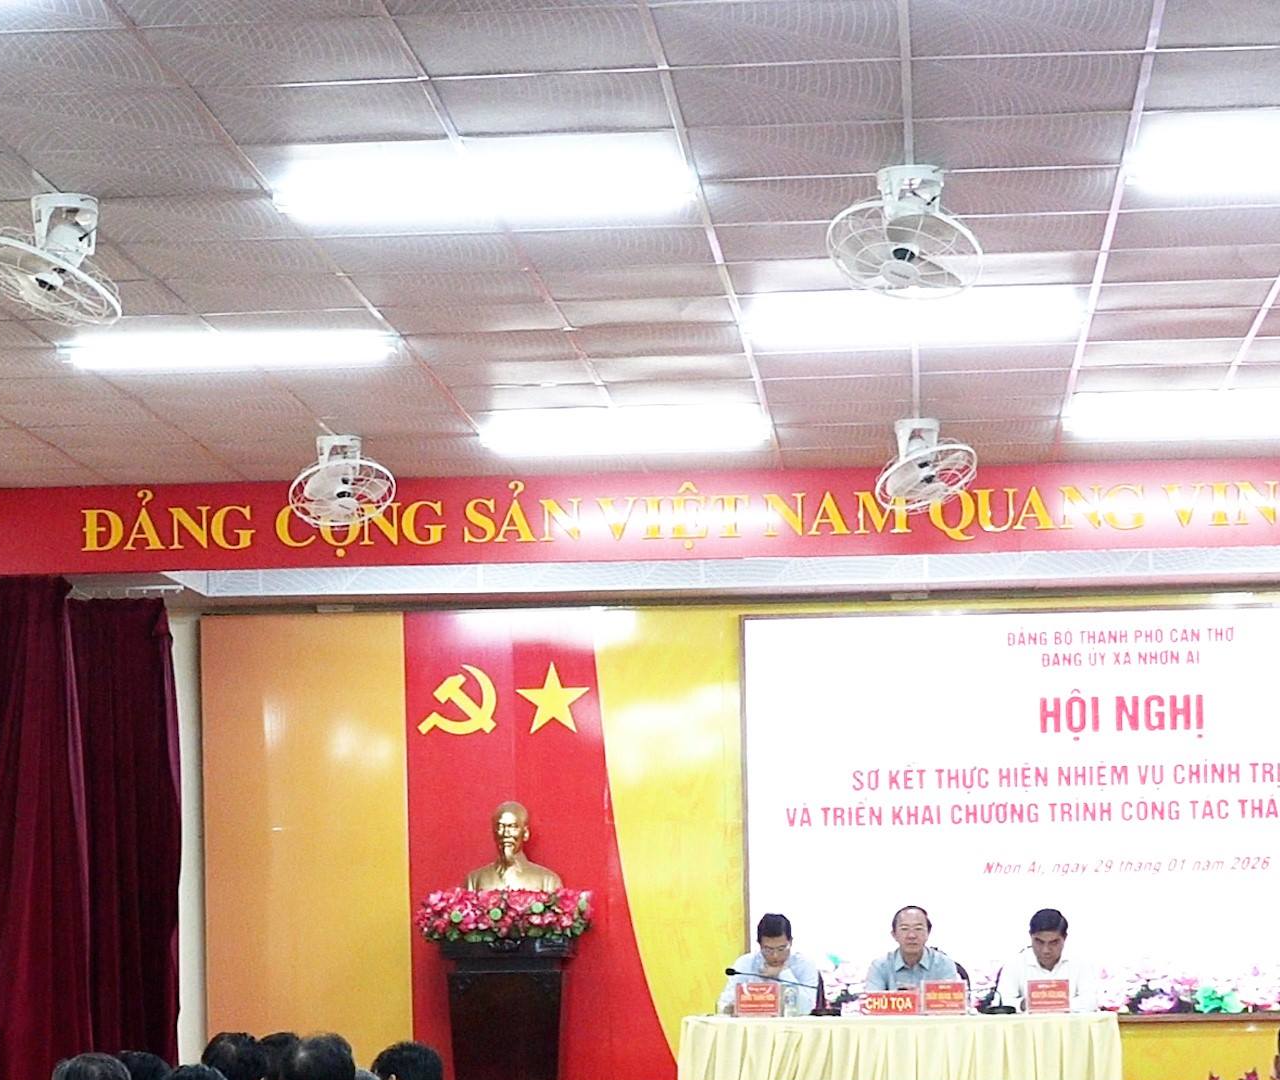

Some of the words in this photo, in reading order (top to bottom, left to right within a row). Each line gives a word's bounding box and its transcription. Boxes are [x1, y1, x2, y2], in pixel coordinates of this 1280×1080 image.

[81, 489, 256, 552] ĐẢNG
[463, 480, 581, 543] SẢN
[597, 481, 750, 550] VIỆT
[762, 489, 912, 536] NAM
[928, 482, 1145, 541] QUANG
[1039, 688, 1100, 741] HỘI
[1115, 694, 1204, 739] NGHỊ
[935, 766, 989, 794] THỰC
[1138, 764, 1164, 790] VỤ
[1249, 762, 1280, 788] TRỊ
[891, 804, 941, 826] KHAI
[950, 801, 1039, 825] CHƯƠNG
[1094, 859, 1114, 873] 29
[1167, 858, 1186, 873] 01
[1231, 857, 1271, 871] 2026
[865, 993, 888, 1010] CHỦ
[890, 996, 913, 1012] TỌA
